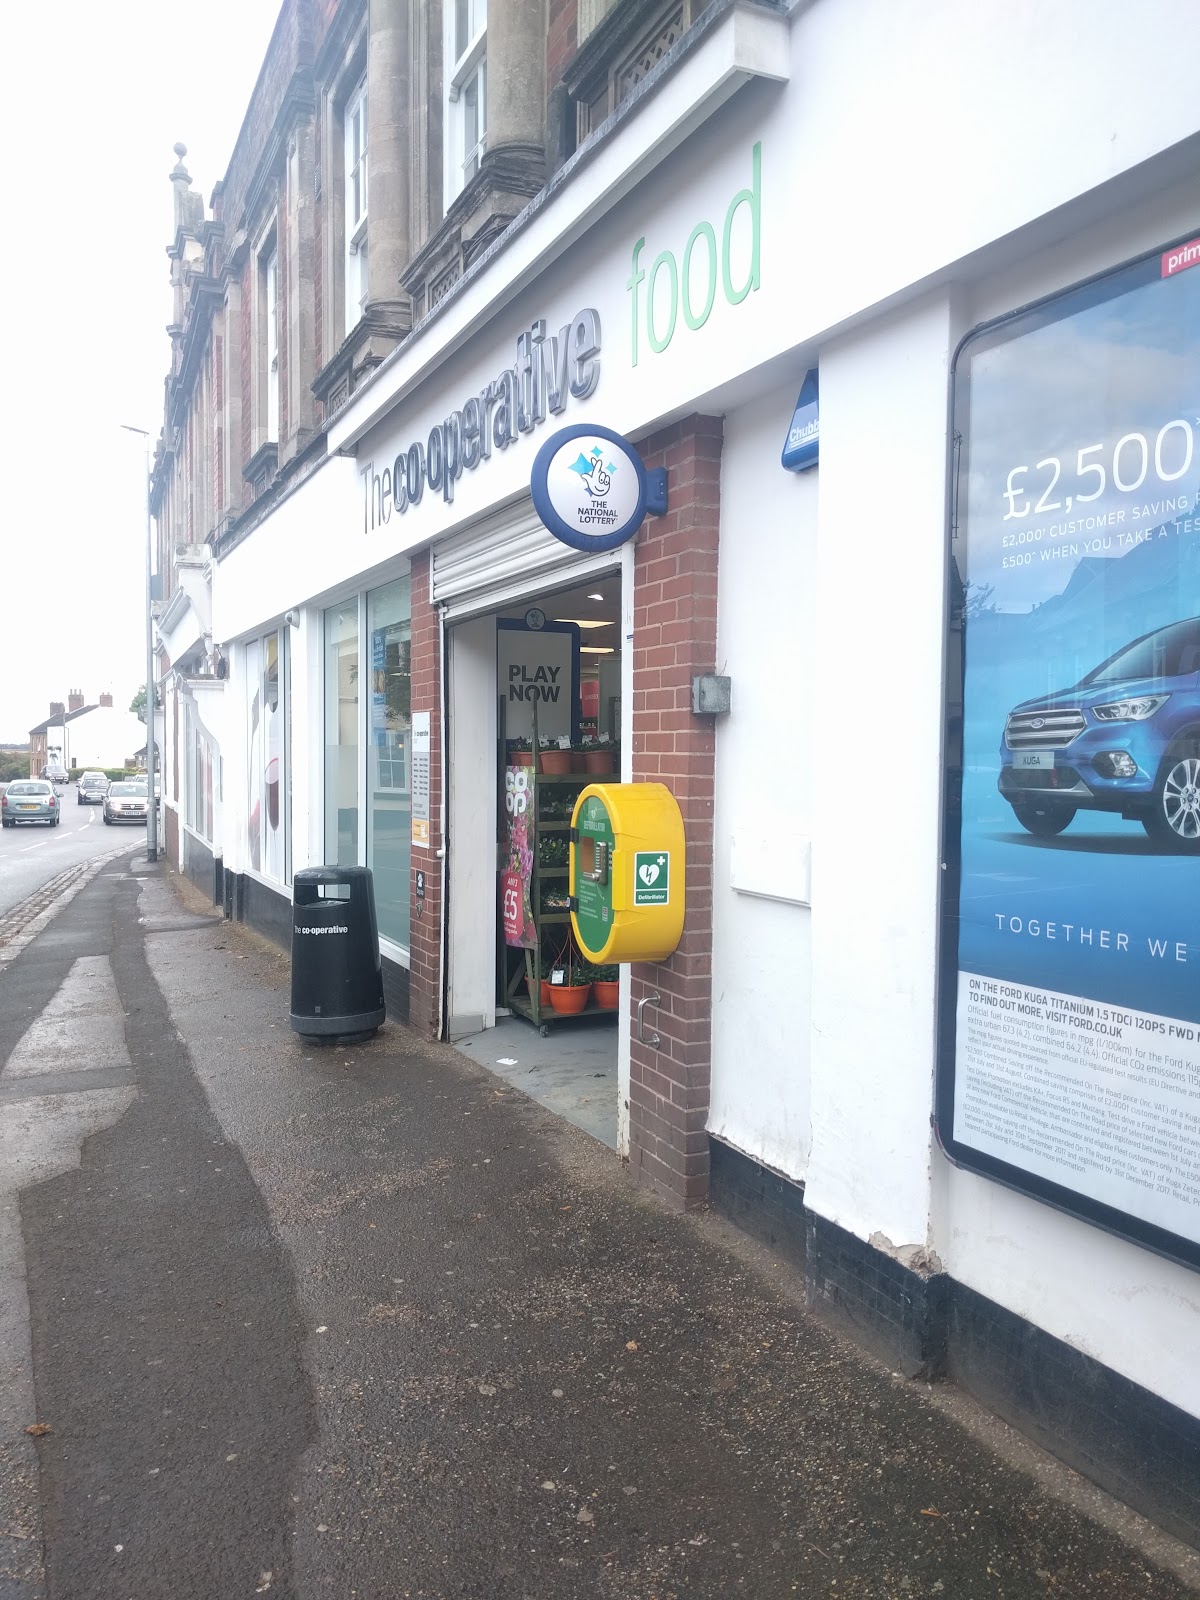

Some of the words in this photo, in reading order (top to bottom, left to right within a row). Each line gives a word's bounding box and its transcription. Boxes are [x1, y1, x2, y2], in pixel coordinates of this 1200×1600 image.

[626, 141, 761, 368] food
[790, 419, 819, 442] Chubb
[360, 461, 392, 534] The
[577, 508, 618, 517] NATIONAL
[579, 516, 616, 525] LOTTERY
[1050, 511, 1125, 537] CUSTOMER
[1132, 495, 1188, 519] SAVING
[1040, 544, 1078, 561] WHEN
[1083, 540, 1112, 554] YOU
[1116, 528, 1153, 547] TAKE
[1158, 526, 1168, 538] A
[508, 665, 561, 683] PLAY
[509, 684, 561, 702] NOW
[1023, 756, 1040, 765] KUGA
[503, 888, 518, 921] £5
[995, 913, 1129, 952] TOGETHER
[1148, 937, 1188, 962] WE
[969, 992, 979, 1002] TO
[980, 994, 998, 1006] FIND
[999, 999, 1016, 1011] OUT
[1046, 1010, 1067, 1024] VISIT
[970, 979, 980, 990] ON
[983, 982, 998, 994] THE
[1000, 986, 1022, 999] FORD
[1025, 992, 1048, 1005] KUGA
[1050, 998, 1093, 1016] TITANIUM
[1097, 1009, 1109, 1020] 1.5
[1111, 1012, 1132, 1026] TDCi
[1135, 1018, 1165, 1034] 120PS
[1169, 1026, 1194, 1041] FWD
[968, 1004, 988, 1017] Official
[991, 1010, 1002, 1020] fuel
[1004, 1014, 1044, 1033] consumption
[1046, 1025, 1068, 1040] figures
[1070, 1031, 1076, 1040] in
[1078, 1035, 1094, 1046] mpg
[1136, 1048, 1146, 1059] for
[1149, 1051, 1162, 1063] the
[1165, 1055, 1182, 1069] Ford
[968, 1015, 983, 1026] extra
[984, 1019, 1001, 1031] urban
[1033, 1032, 1064, 1049] combined
[1102, 1051, 1128, 1066] Official
[1130, 1058, 1144, 1071] CO2
[1147, 1063, 1185, 1082] emissions
[1188, 1074, 1200, 1086] 115
